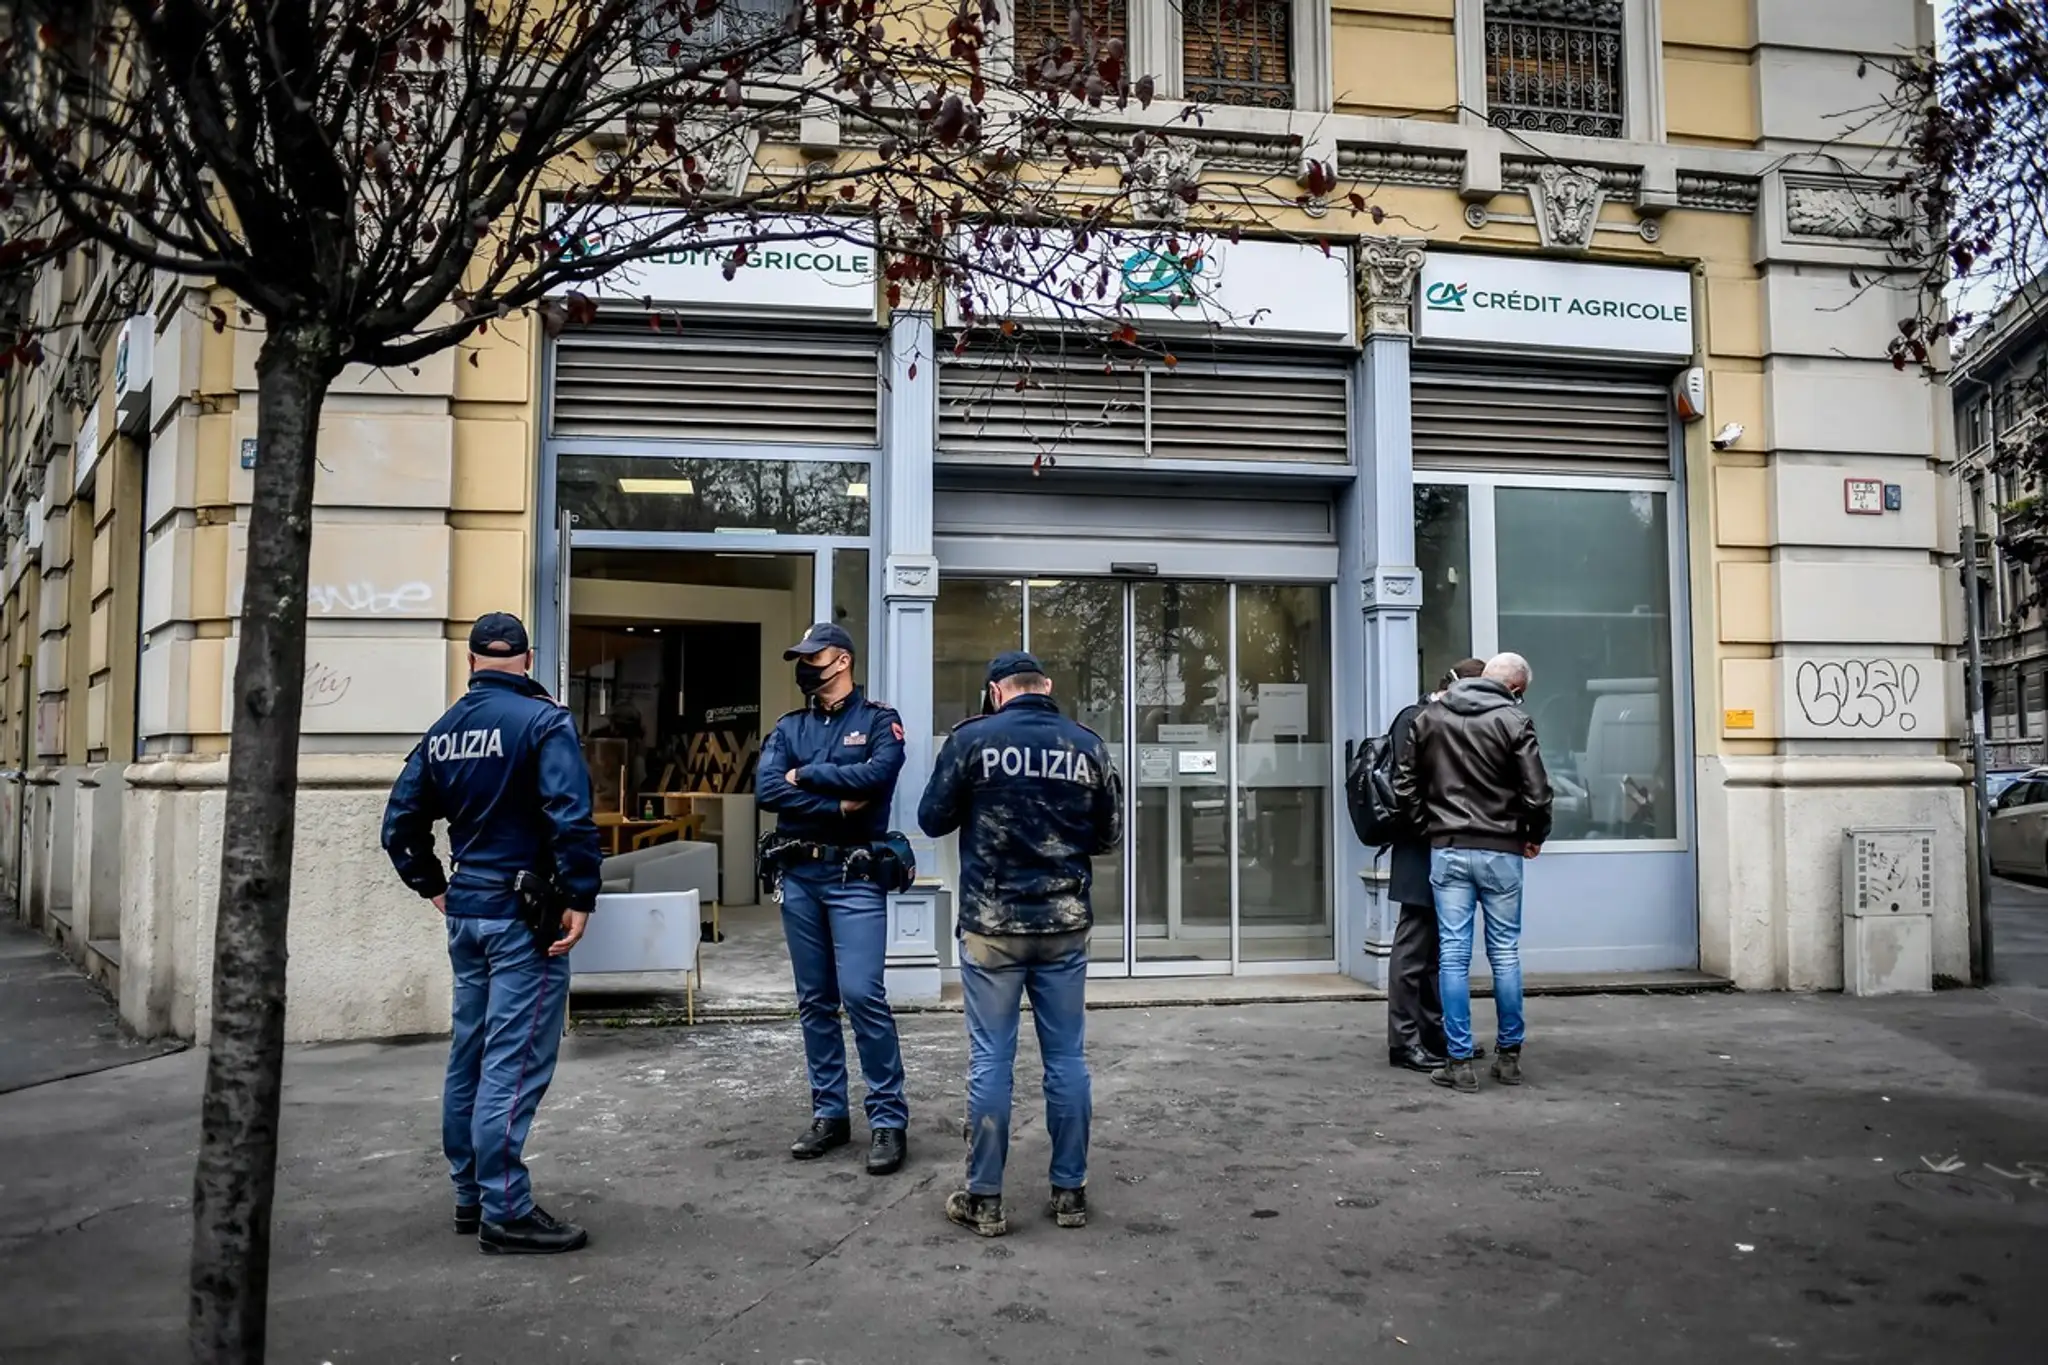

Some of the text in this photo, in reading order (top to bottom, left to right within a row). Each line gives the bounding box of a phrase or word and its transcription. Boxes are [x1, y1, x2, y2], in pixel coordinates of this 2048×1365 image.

[1473, 290, 1562, 313] CRÉDIT
[1568, 299, 1688, 323] AGRICOLE
[427, 728, 504, 764] POLIZIA
[981, 746, 1091, 783] POLIZIA
